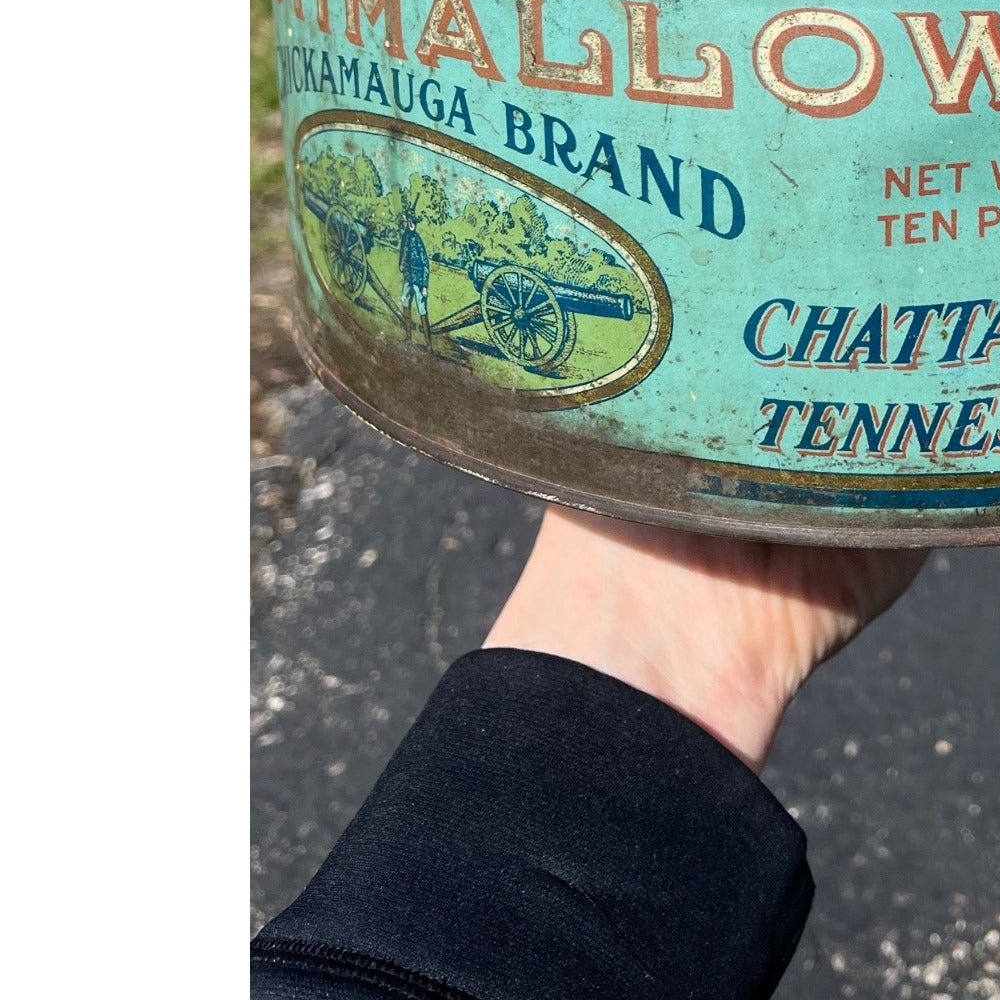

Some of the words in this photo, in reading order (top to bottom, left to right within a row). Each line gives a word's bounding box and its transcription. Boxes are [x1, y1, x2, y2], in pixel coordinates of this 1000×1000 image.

[502, 101, 747, 240] BRAND
[883, 161, 971, 199] NET
[877, 209, 958, 247] TEN
